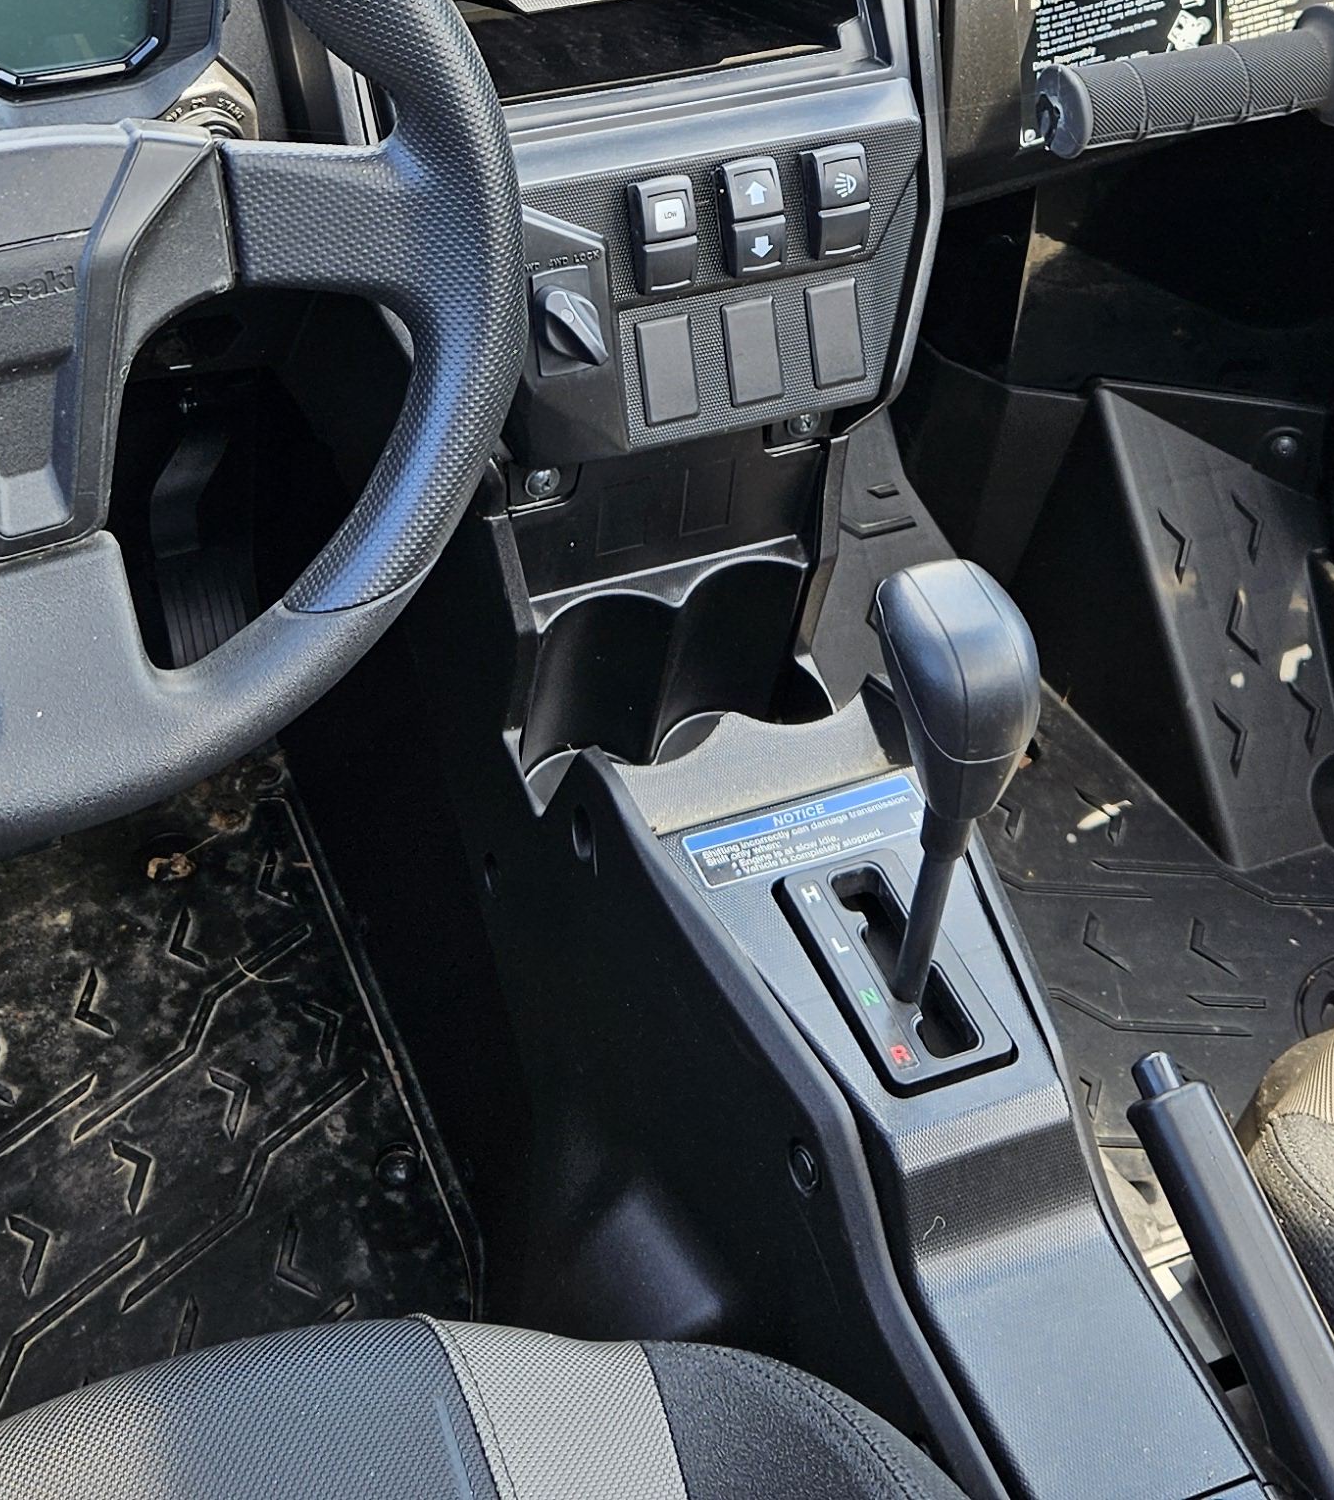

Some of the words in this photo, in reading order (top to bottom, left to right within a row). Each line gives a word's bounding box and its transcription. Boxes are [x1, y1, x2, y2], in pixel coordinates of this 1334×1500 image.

[216, 97, 246, 121] START
[663, 210, 678, 220] LOW
[573, 249, 601, 264] LOCK
[740, 830, 790, 850] incorrectly
[791, 825, 810, 835] can
[810, 813, 848, 830] damage
[848, 795, 910, 818] transmission.
[772, 803, 826, 827] NOTICE
[730, 849, 751, 861] only
[738, 853, 772, 866] Engine
[795, 839, 817, 852] slow
[741, 860, 779, 874] Vehicle
[790, 841, 841, 862] completely
[841, 828, 885, 847] stopped.
[800, 886, 821, 903] H
[831, 937, 849, 953] L
[859, 987, 880, 1006] N
[890, 1044, 911, 1064] R
